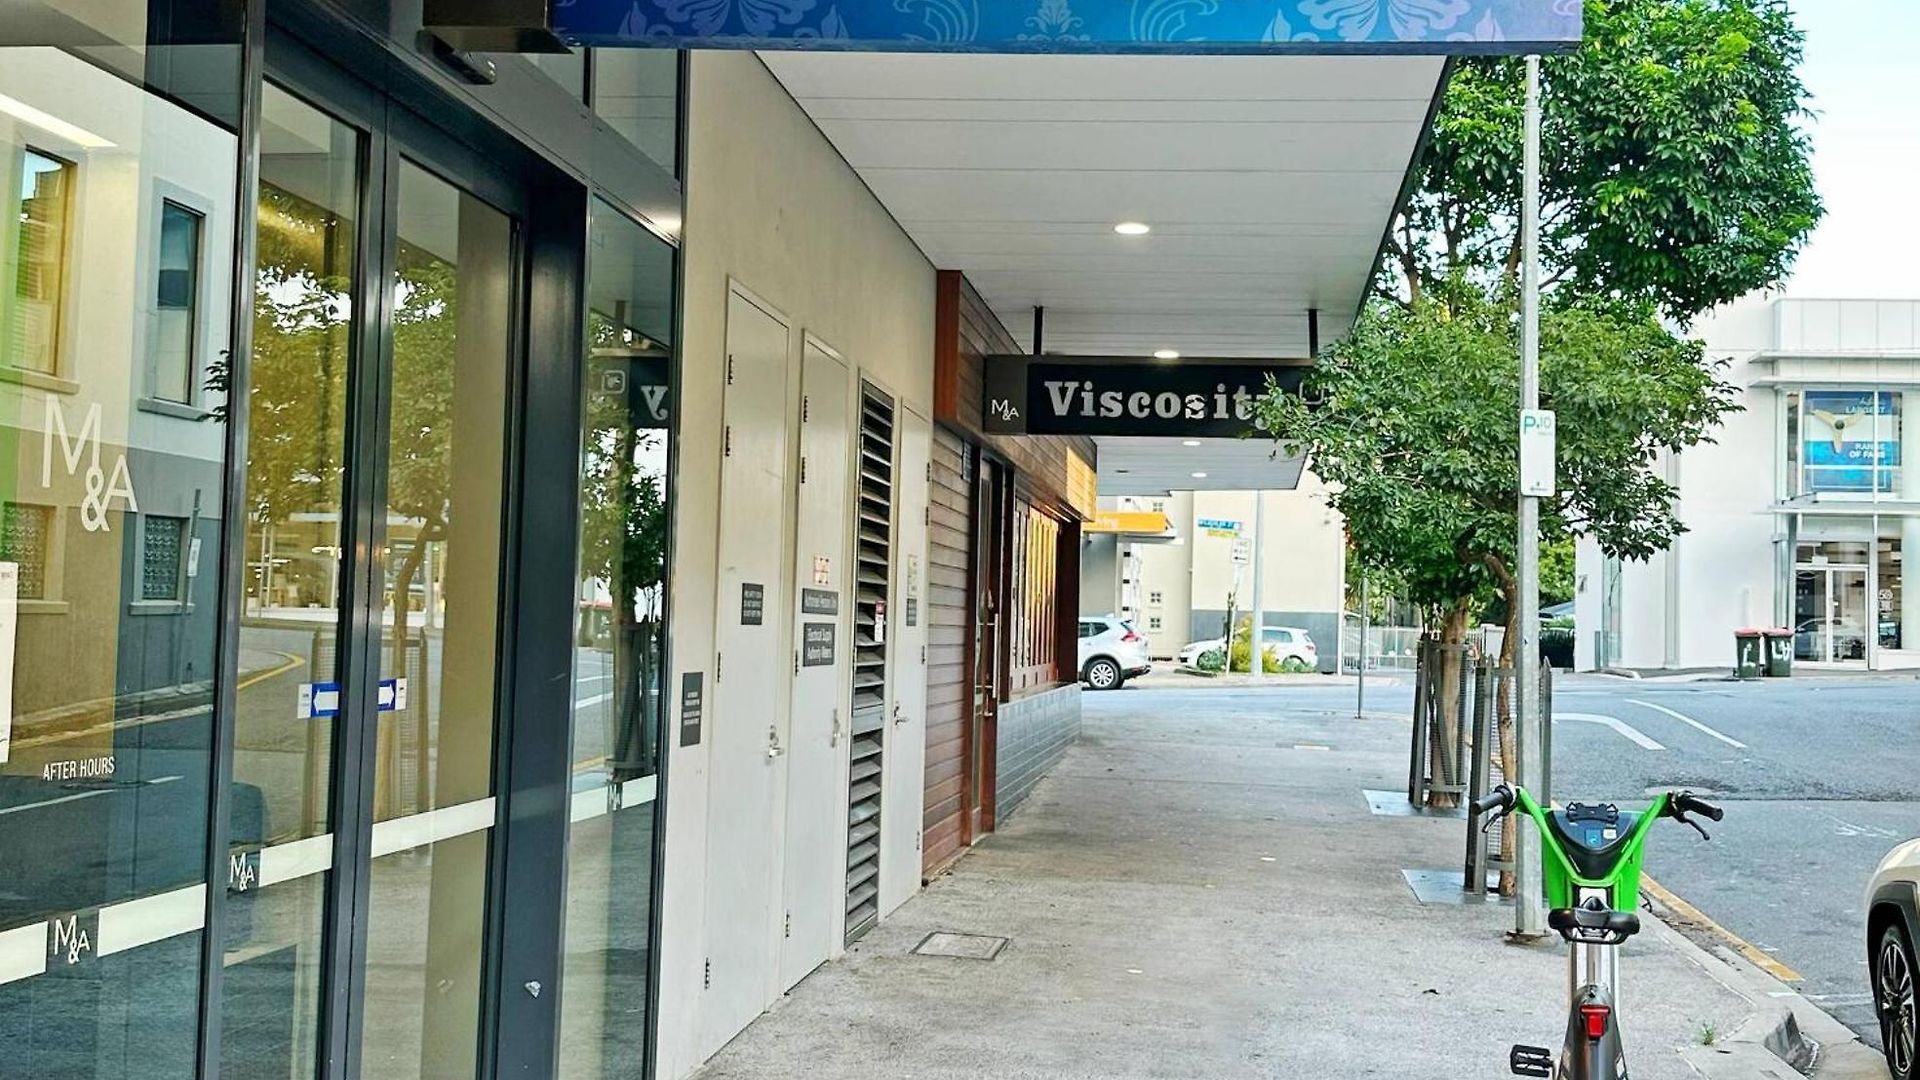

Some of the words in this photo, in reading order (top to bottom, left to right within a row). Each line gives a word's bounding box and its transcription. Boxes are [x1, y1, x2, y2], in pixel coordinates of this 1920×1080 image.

[992, 399, 1020, 421] M&A
[42, 394, 138, 531] M&A
[1849, 450, 1861, 458] OF
[43, 761, 77, 781] AFTER
[80, 756, 115, 777] HOURS
[230, 852, 255, 891] M&A
[54, 914, 90, 964] M&A
